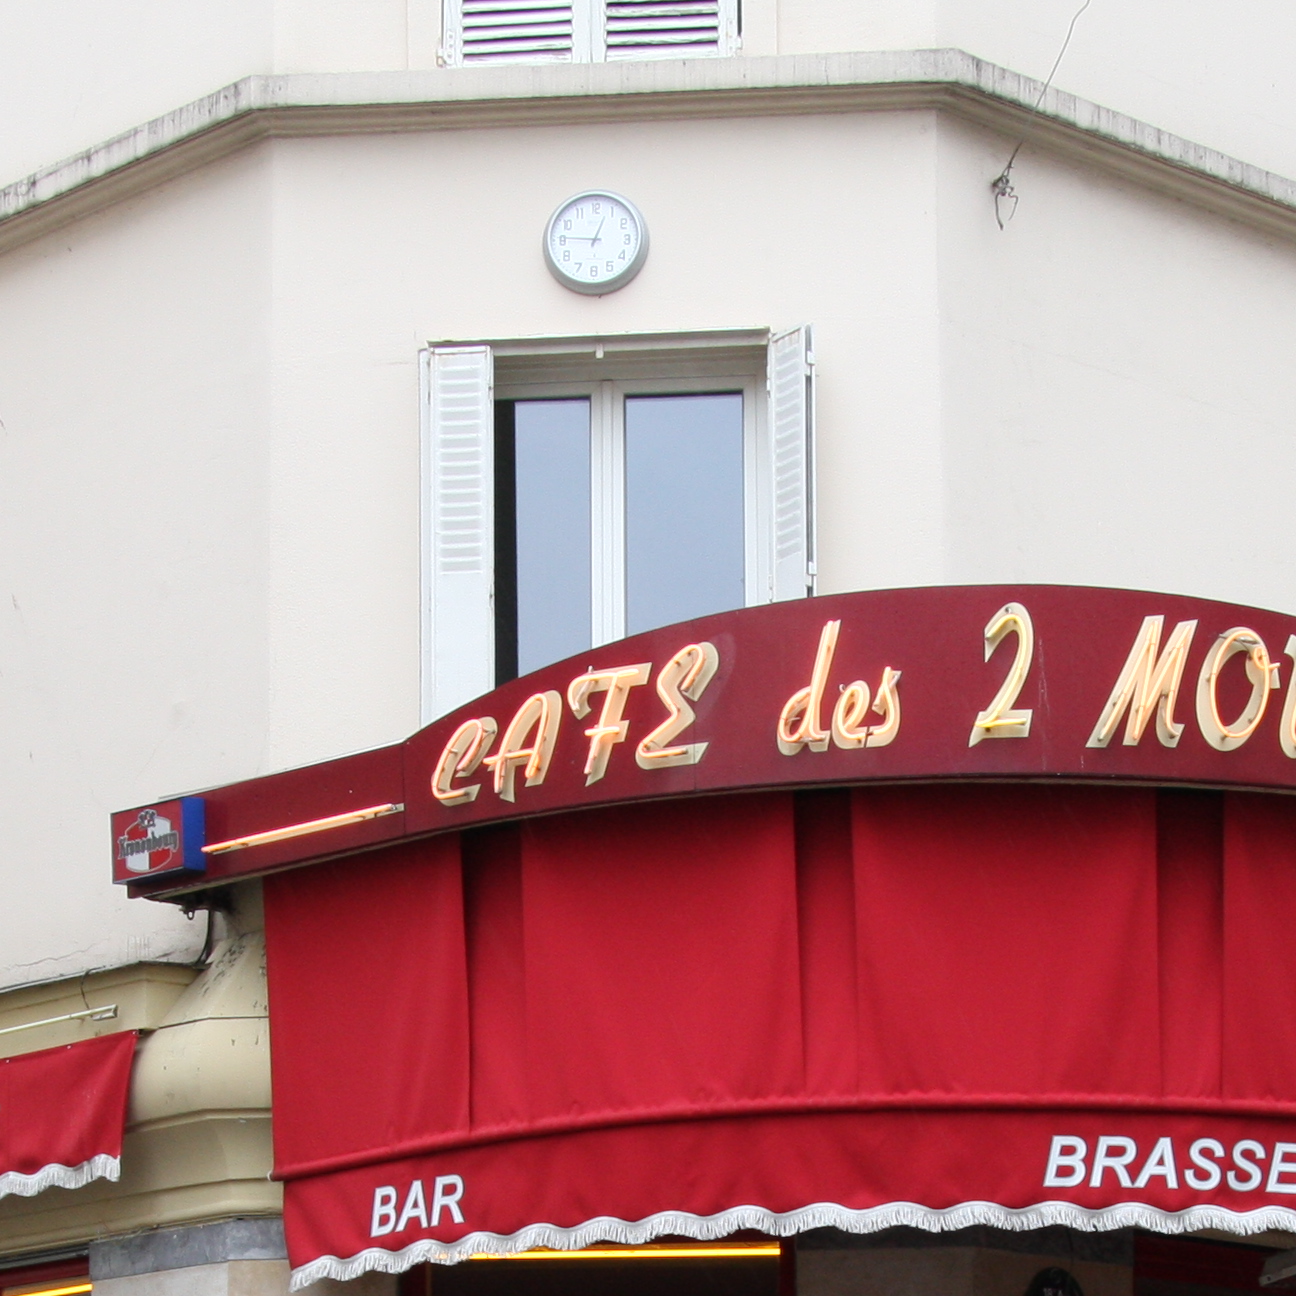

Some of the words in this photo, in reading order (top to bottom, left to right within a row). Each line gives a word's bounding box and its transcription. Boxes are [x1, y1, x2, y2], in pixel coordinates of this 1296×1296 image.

[576, 207, 584, 219] 11
[592, 203, 601, 214] 12
[610, 206, 614, 218] 1
[564, 219, 572, 230] 10
[620, 218, 627, 229] 2
[624, 234, 631, 245] 3
[563, 250, 570, 261] 8
[618, 249, 625, 261] 4
[574, 262, 582, 273] 7
[606, 261, 614, 272] 5
[431, 641, 720, 807] CAFE
[777, 619, 902, 756] des
[968, 602, 1035, 748] 2
[370, 1173, 465, 1238] BAR
